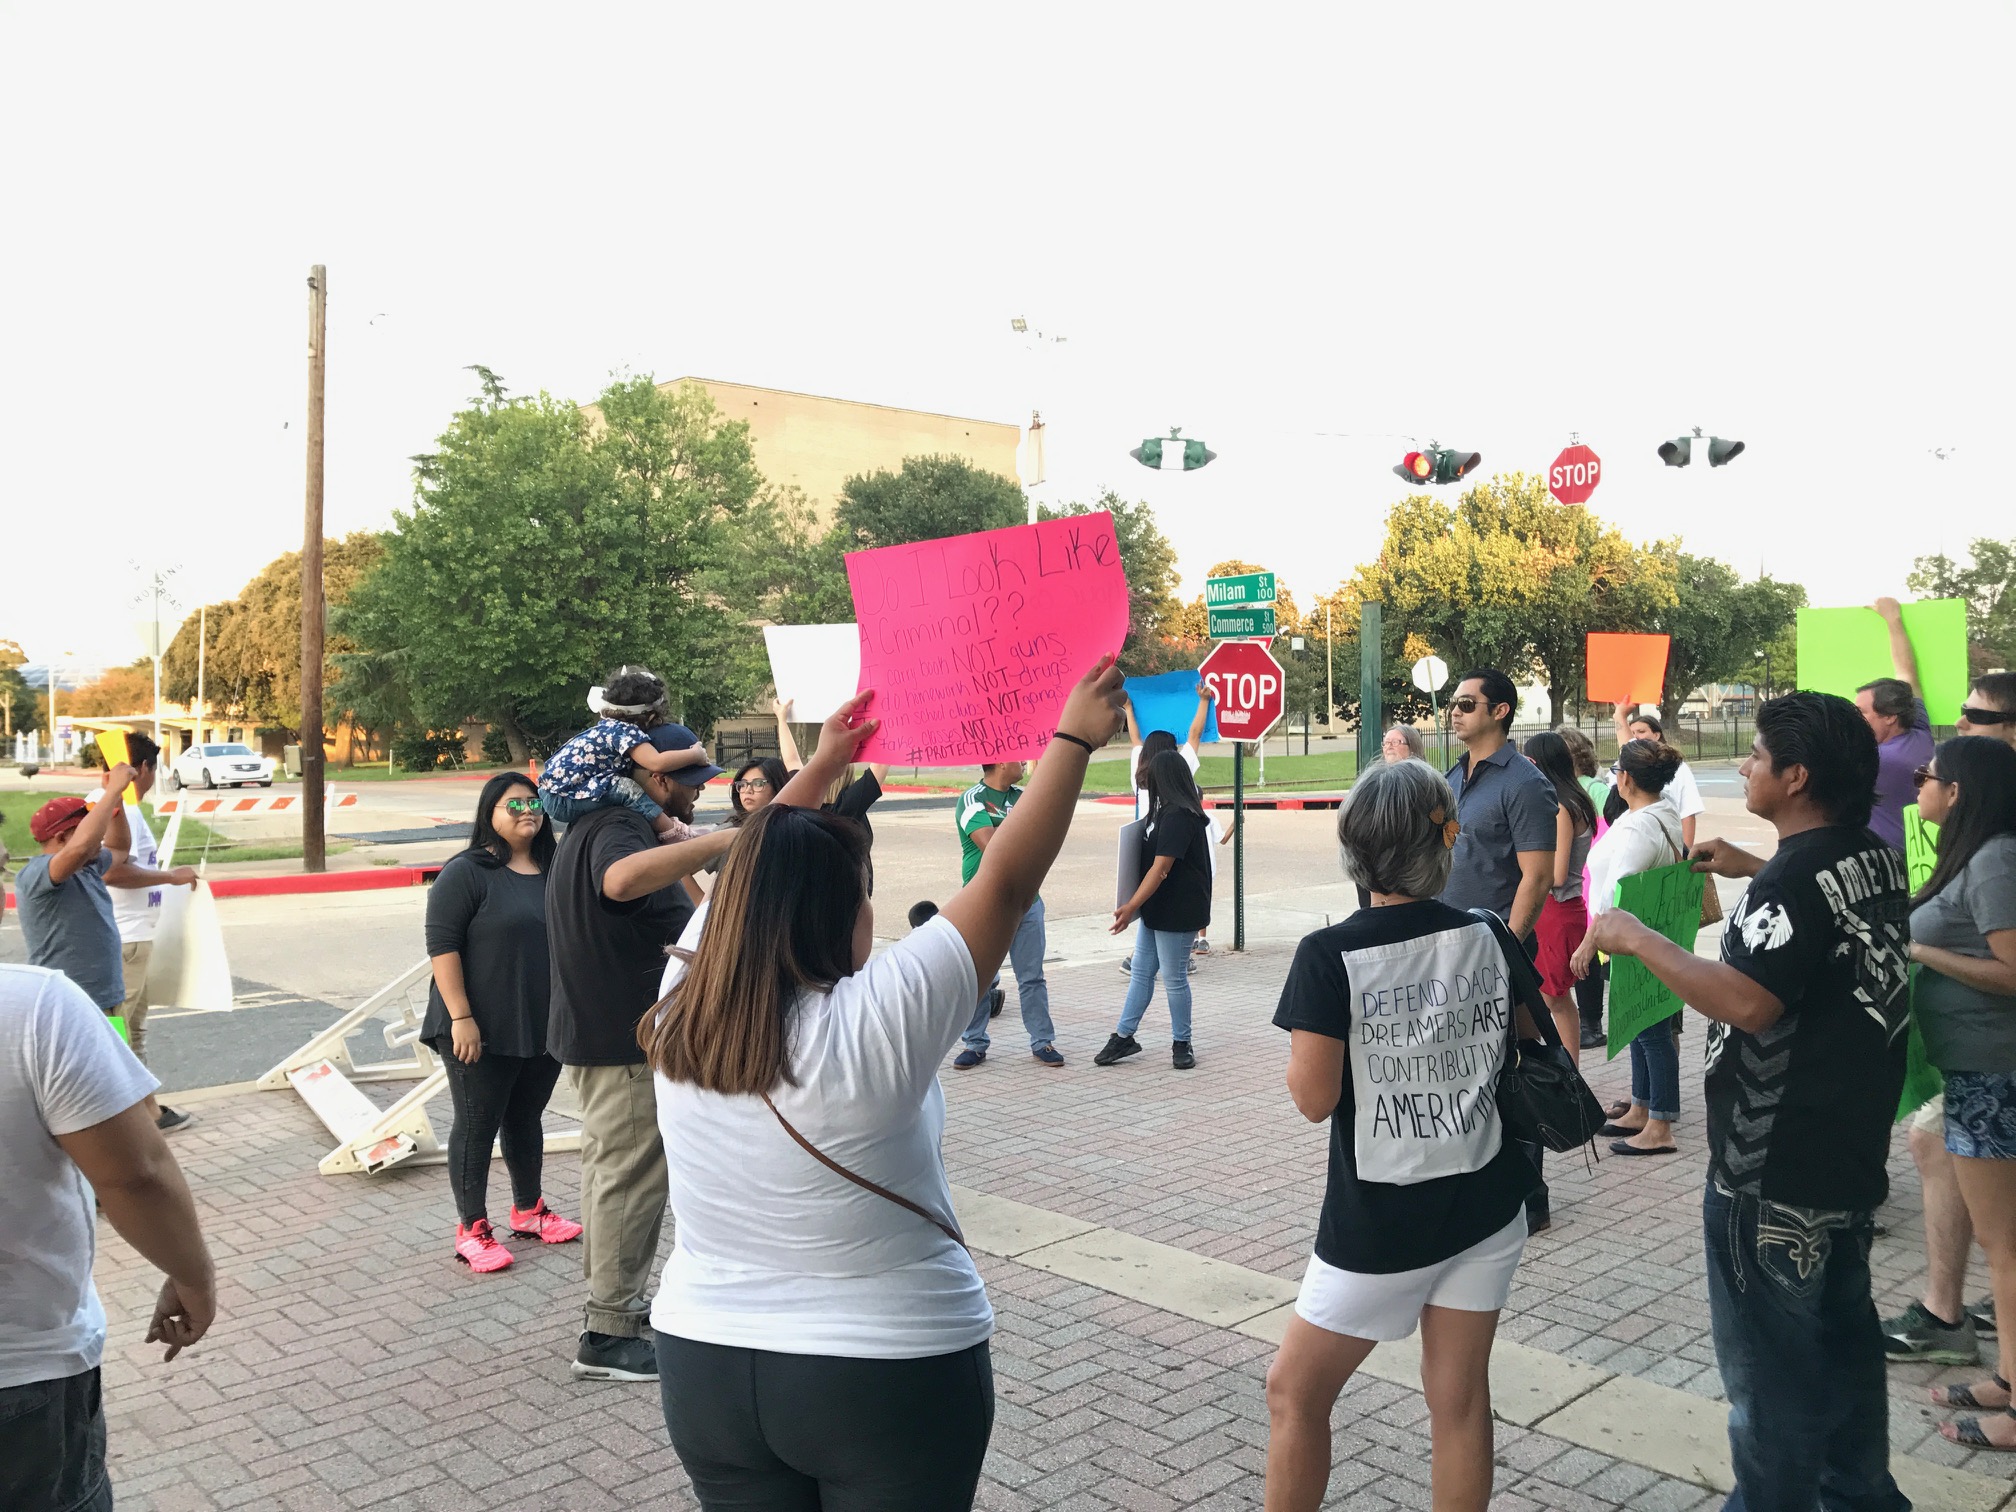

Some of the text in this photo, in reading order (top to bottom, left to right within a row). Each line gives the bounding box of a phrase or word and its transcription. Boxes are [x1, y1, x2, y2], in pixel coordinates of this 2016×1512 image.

[1551, 461, 1599, 489] STOP
[853, 527, 1116, 615] Do I Look Like
[1207, 576, 1268, 602] Milam St
[1257, 588, 1273, 600] 100
[861, 623, 873, 654] A
[1211, 611, 1271, 633] Commerce St
[1262, 623, 1274, 634] 500
[887, 667, 918, 690] carry
[952, 637, 995, 673] NOT
[881, 691, 900, 712] do
[905, 680, 970, 708] homework
[972, 666, 1009, 694] NOT
[1204, 672, 1277, 710] STOP
[876, 712, 910, 741] join
[914, 703, 945, 726] school
[949, 700, 985, 720] clubs
[987, 689, 1020, 715] NOT
[880, 736, 913, 751] take
[961, 718, 987, 742] NOT
[1362, 963, 1508, 1018] DEFEND DACA
[1361, 997, 1508, 1047] DREAMERS ARE
[1368, 1039, 1500, 1084] CONTRIBUTIN
